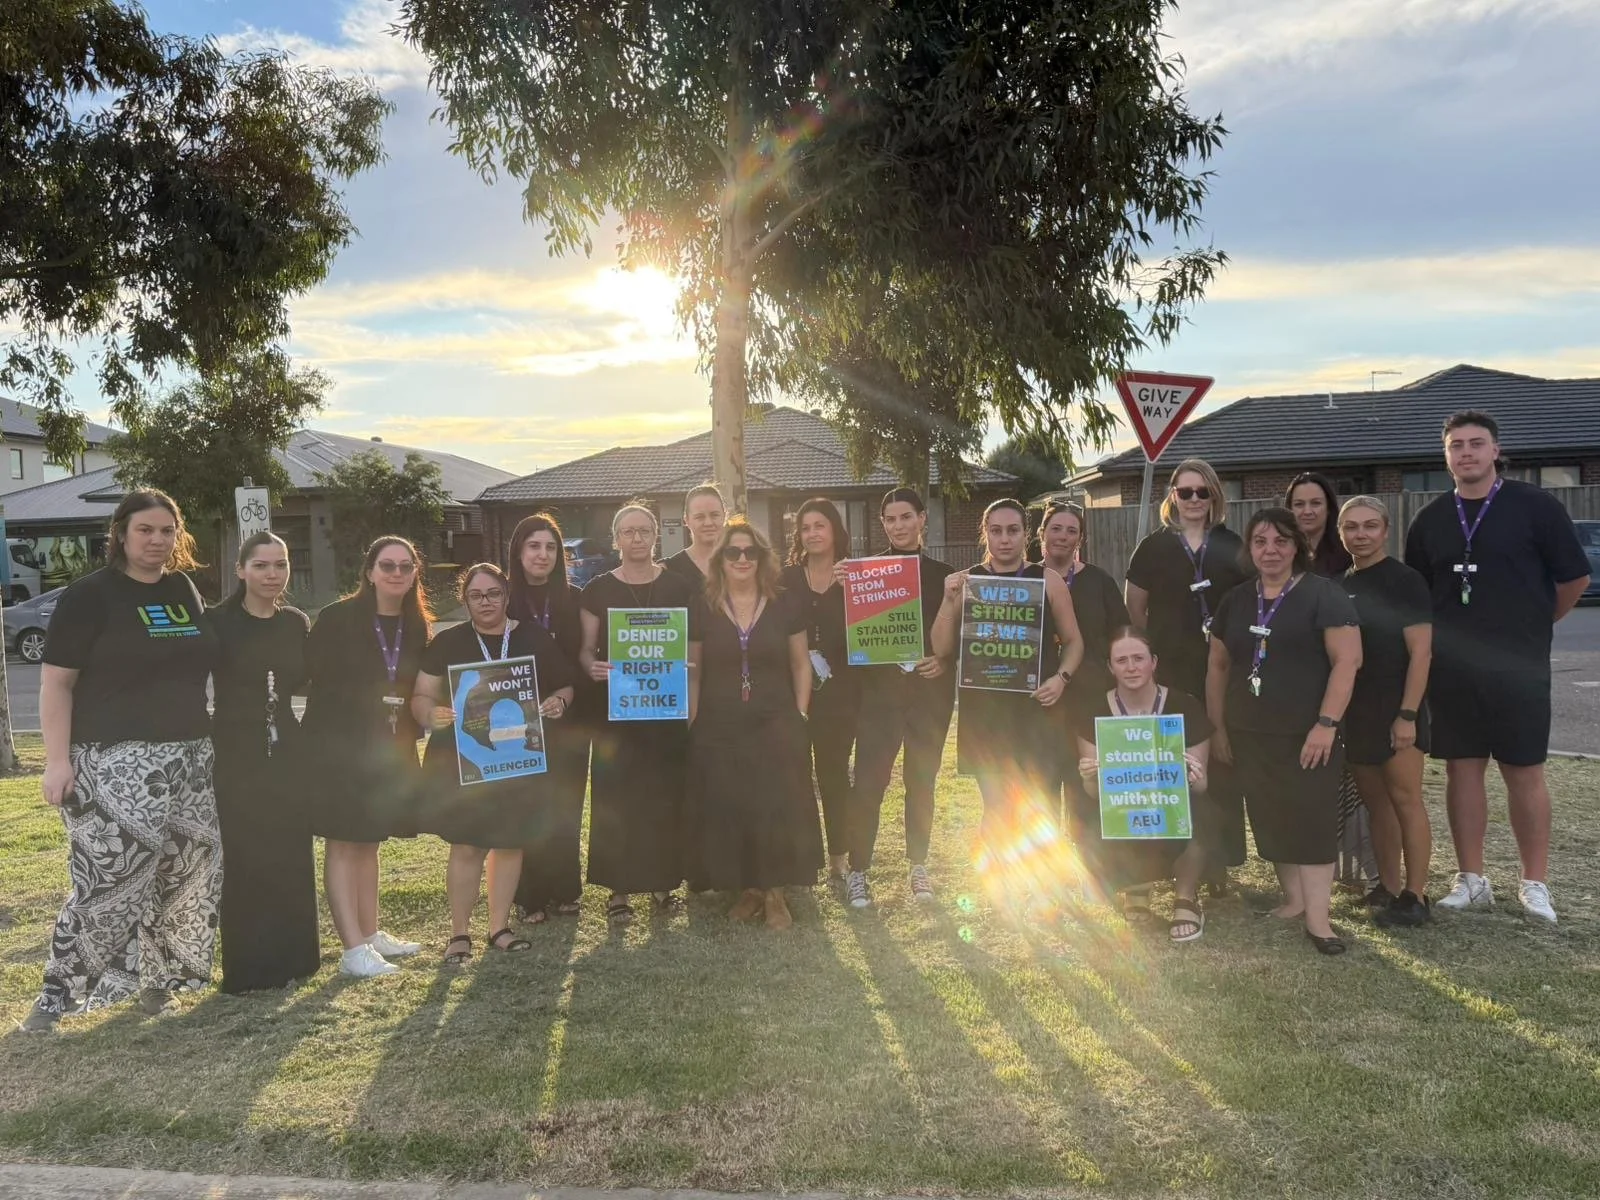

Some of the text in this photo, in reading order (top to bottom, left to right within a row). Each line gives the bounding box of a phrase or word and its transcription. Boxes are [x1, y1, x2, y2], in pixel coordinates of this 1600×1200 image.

[1138, 388, 1182, 405] GIVE
[1143, 405, 1173, 419] WAY
[848, 563, 903, 582] BLOCKED
[850, 578, 885, 593] FROM
[852, 587, 910, 605] STRIKING.
[978, 586, 1030, 603] WE'D
[137, 604, 190, 625] IEU
[888, 611, 918, 622] STILL
[971, 604, 1036, 622] STRIKE
[617, 628, 679, 642] DENIED
[856, 623, 918, 636] STANDING
[976, 623, 1027, 641] IF WE
[858, 635, 918, 648] WITH AEU.
[628, 645, 665, 659] OUR
[969, 641, 1034, 659] COULD
[510, 664, 531, 676] WE
[622, 661, 673, 675] RIGHT
[488, 677, 532, 692] WON'T
[636, 678, 660, 691] TO
[518, 689, 534, 701] BE
[620, 694, 677, 708] STRIKE
[1124, 728, 1152, 741] We
[1105, 747, 1174, 763] stand in
[482, 757, 543, 775] SILENCED!
[1106, 767, 1179, 785] solidarity
[1109, 791, 1180, 806] with the
[1131, 814, 1161, 827] AEU
